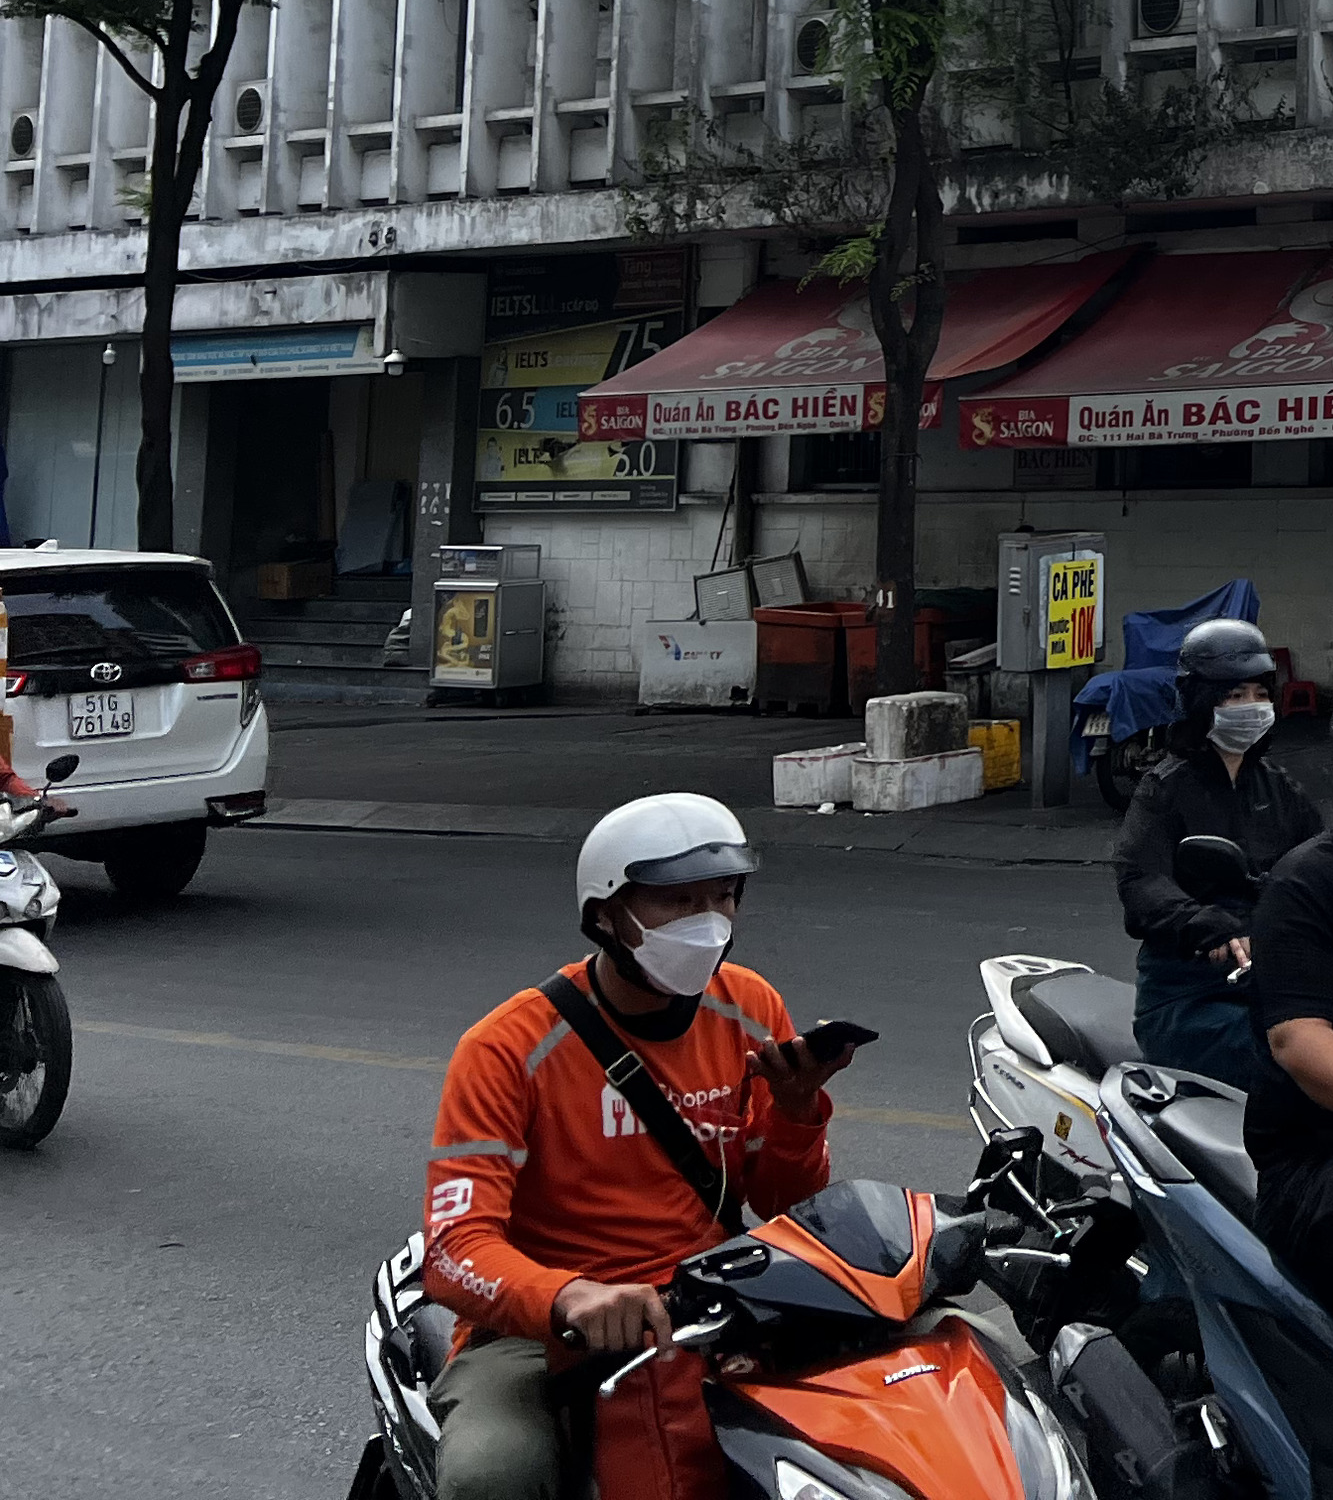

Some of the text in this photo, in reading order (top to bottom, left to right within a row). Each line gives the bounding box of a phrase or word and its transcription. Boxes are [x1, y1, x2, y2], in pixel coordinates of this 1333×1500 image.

[515, 351, 548, 368] IELTS
[792, 345, 849, 359] BIA
[1256, 342, 1315, 358] BIA
[700, 356, 884, 380] SAIGON
[496, 391, 537, 429] 6.5
[653, 398, 690, 425] Quán
[695, 395, 714, 422] Ăn
[725, 393, 780, 422] BÁC
[1018, 410, 1036, 420] BIA
[1079, 405, 1133, 431] Quán
[1141, 399, 1169, 427] Ăn
[1182, 395, 1261, 427] BÁC
[600, 413, 644, 430] SAIGON
[1000, 420, 1054, 438] SAIGON
[1072, 562, 1095, 599] PHÊ
[1071, 605, 1095, 659] 10K
[86, 694, 118, 713] 51G
